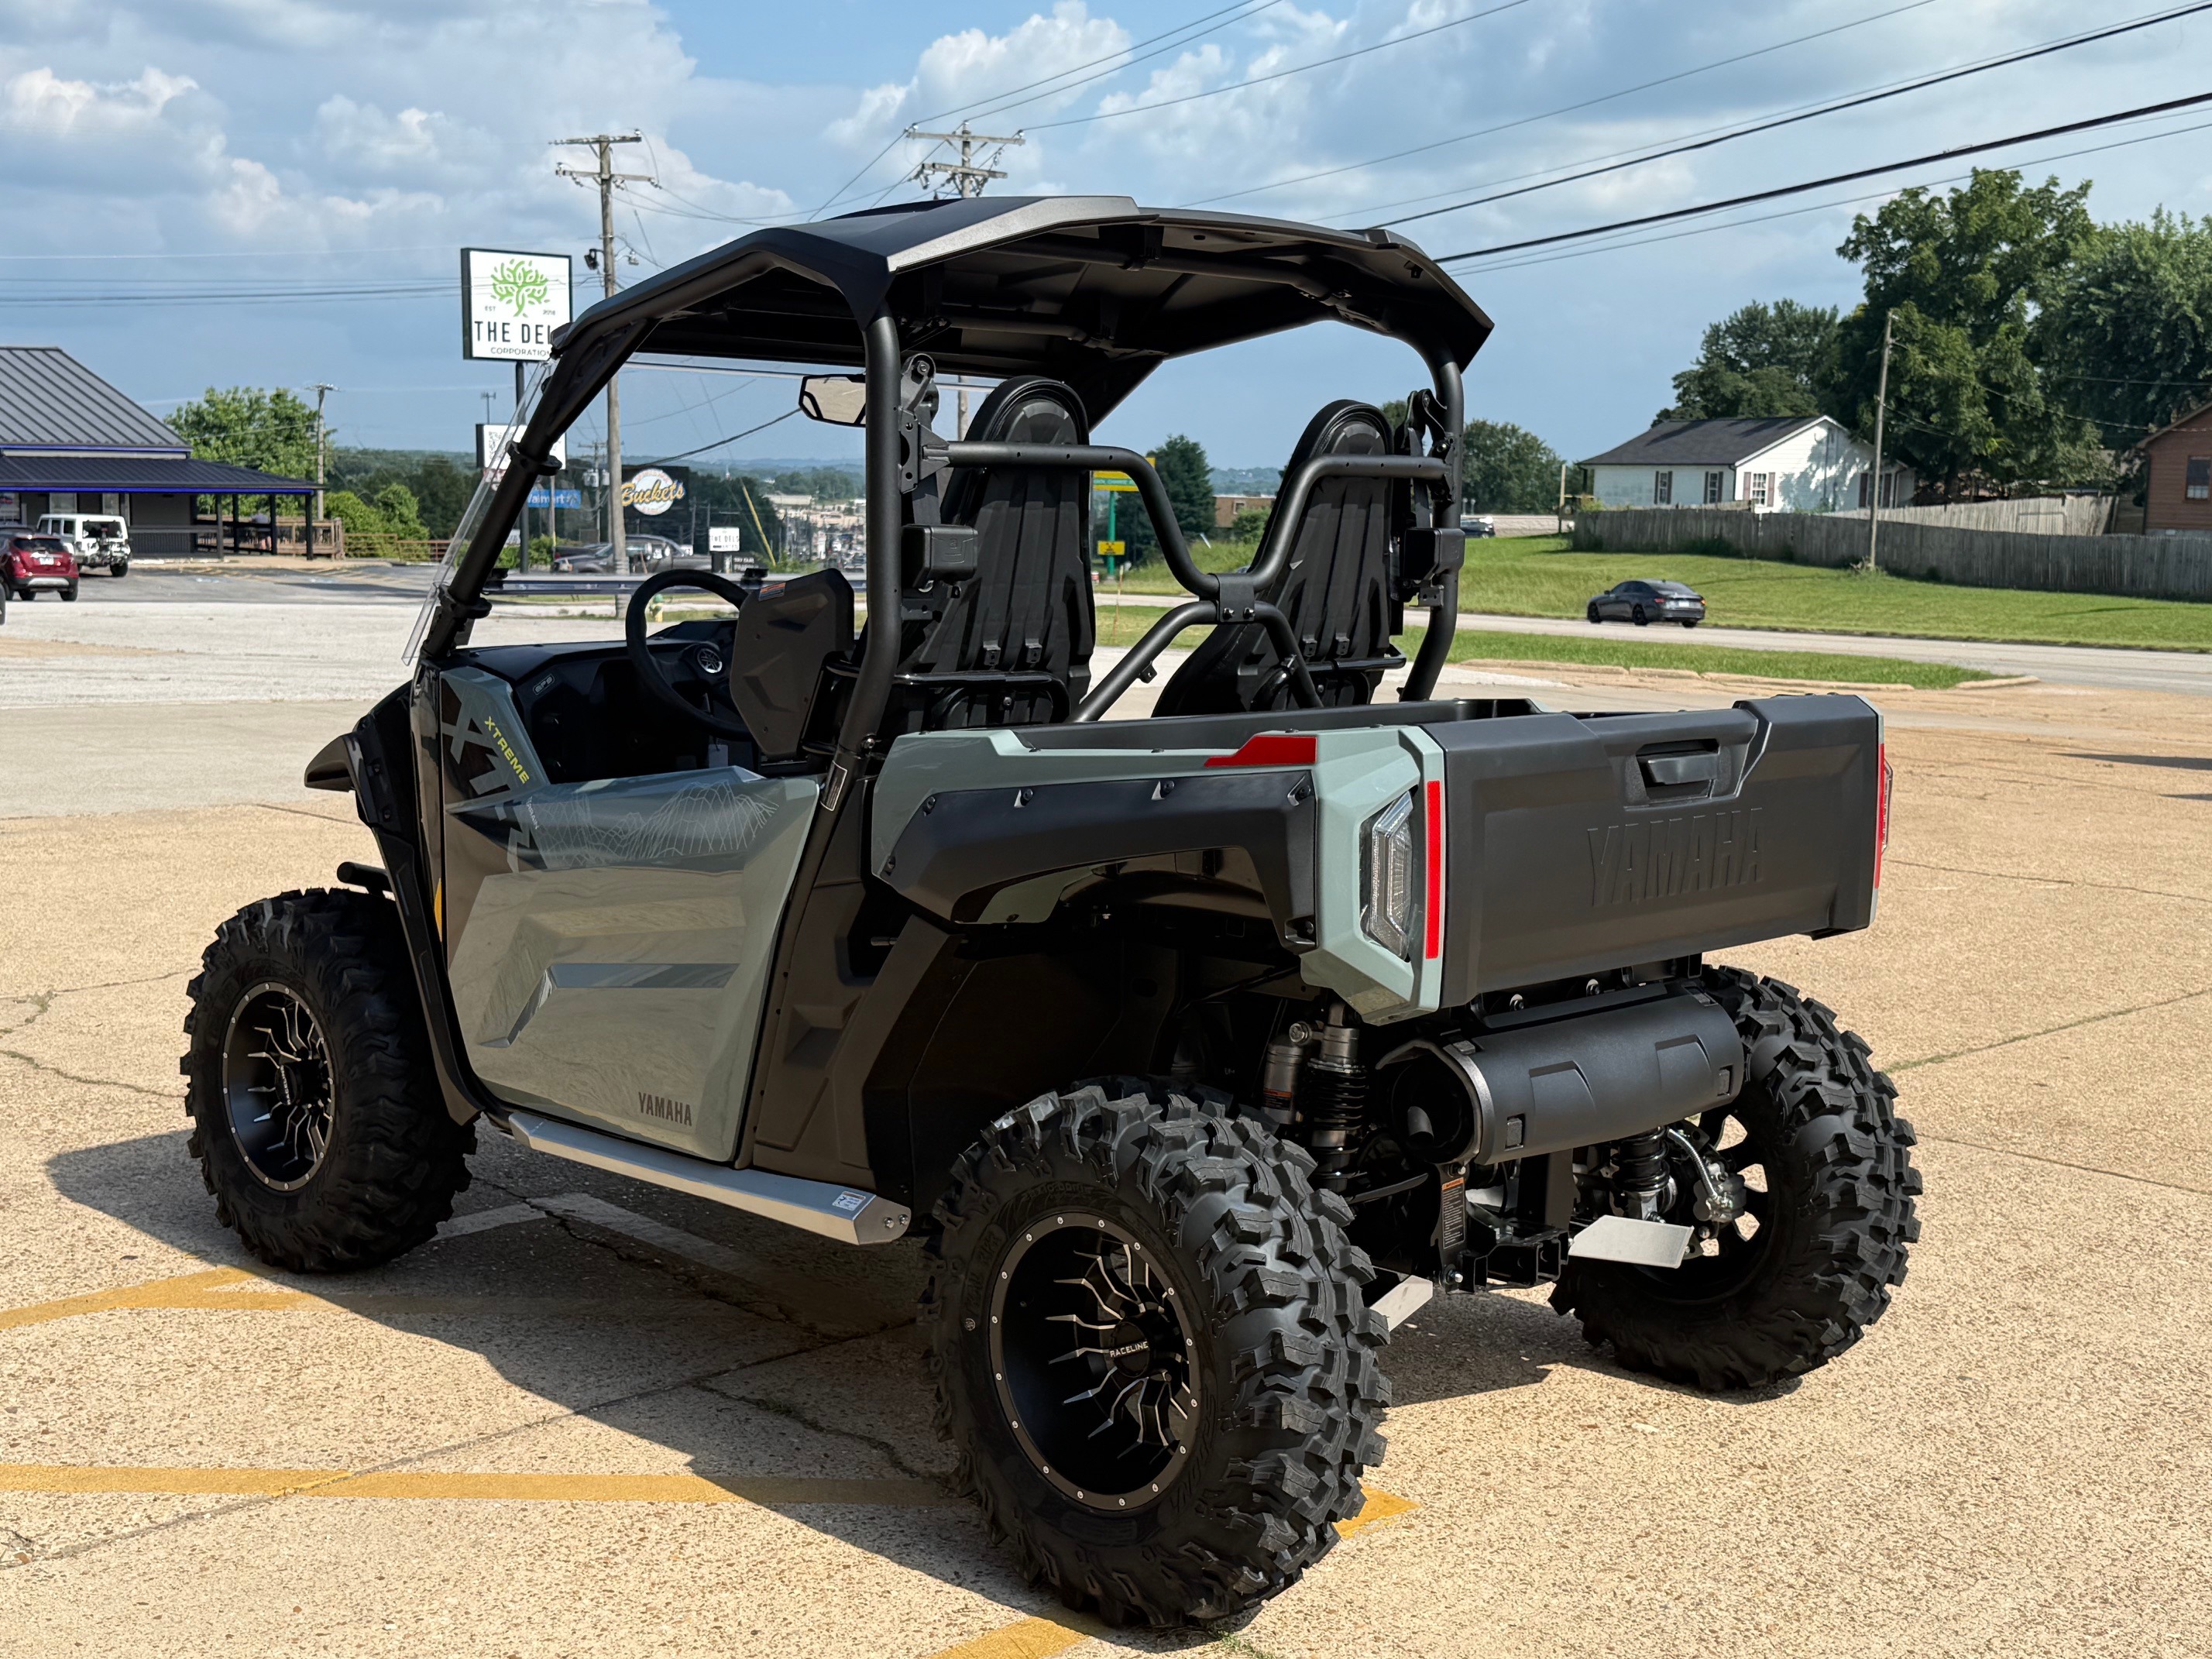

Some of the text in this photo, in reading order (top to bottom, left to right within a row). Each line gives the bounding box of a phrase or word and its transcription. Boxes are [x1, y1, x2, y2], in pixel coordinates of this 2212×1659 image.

[474, 321, 552, 345] THE DEL
[527, 492, 565, 503] almrt
[620, 479, 686, 507] Buckets
[484, 716, 530, 785] XTREME
[1587, 806, 1766, 907] YAMAHA
[638, 1091, 692, 1127] YAMAHA
[1109, 1341, 1149, 1358] RACELINE
